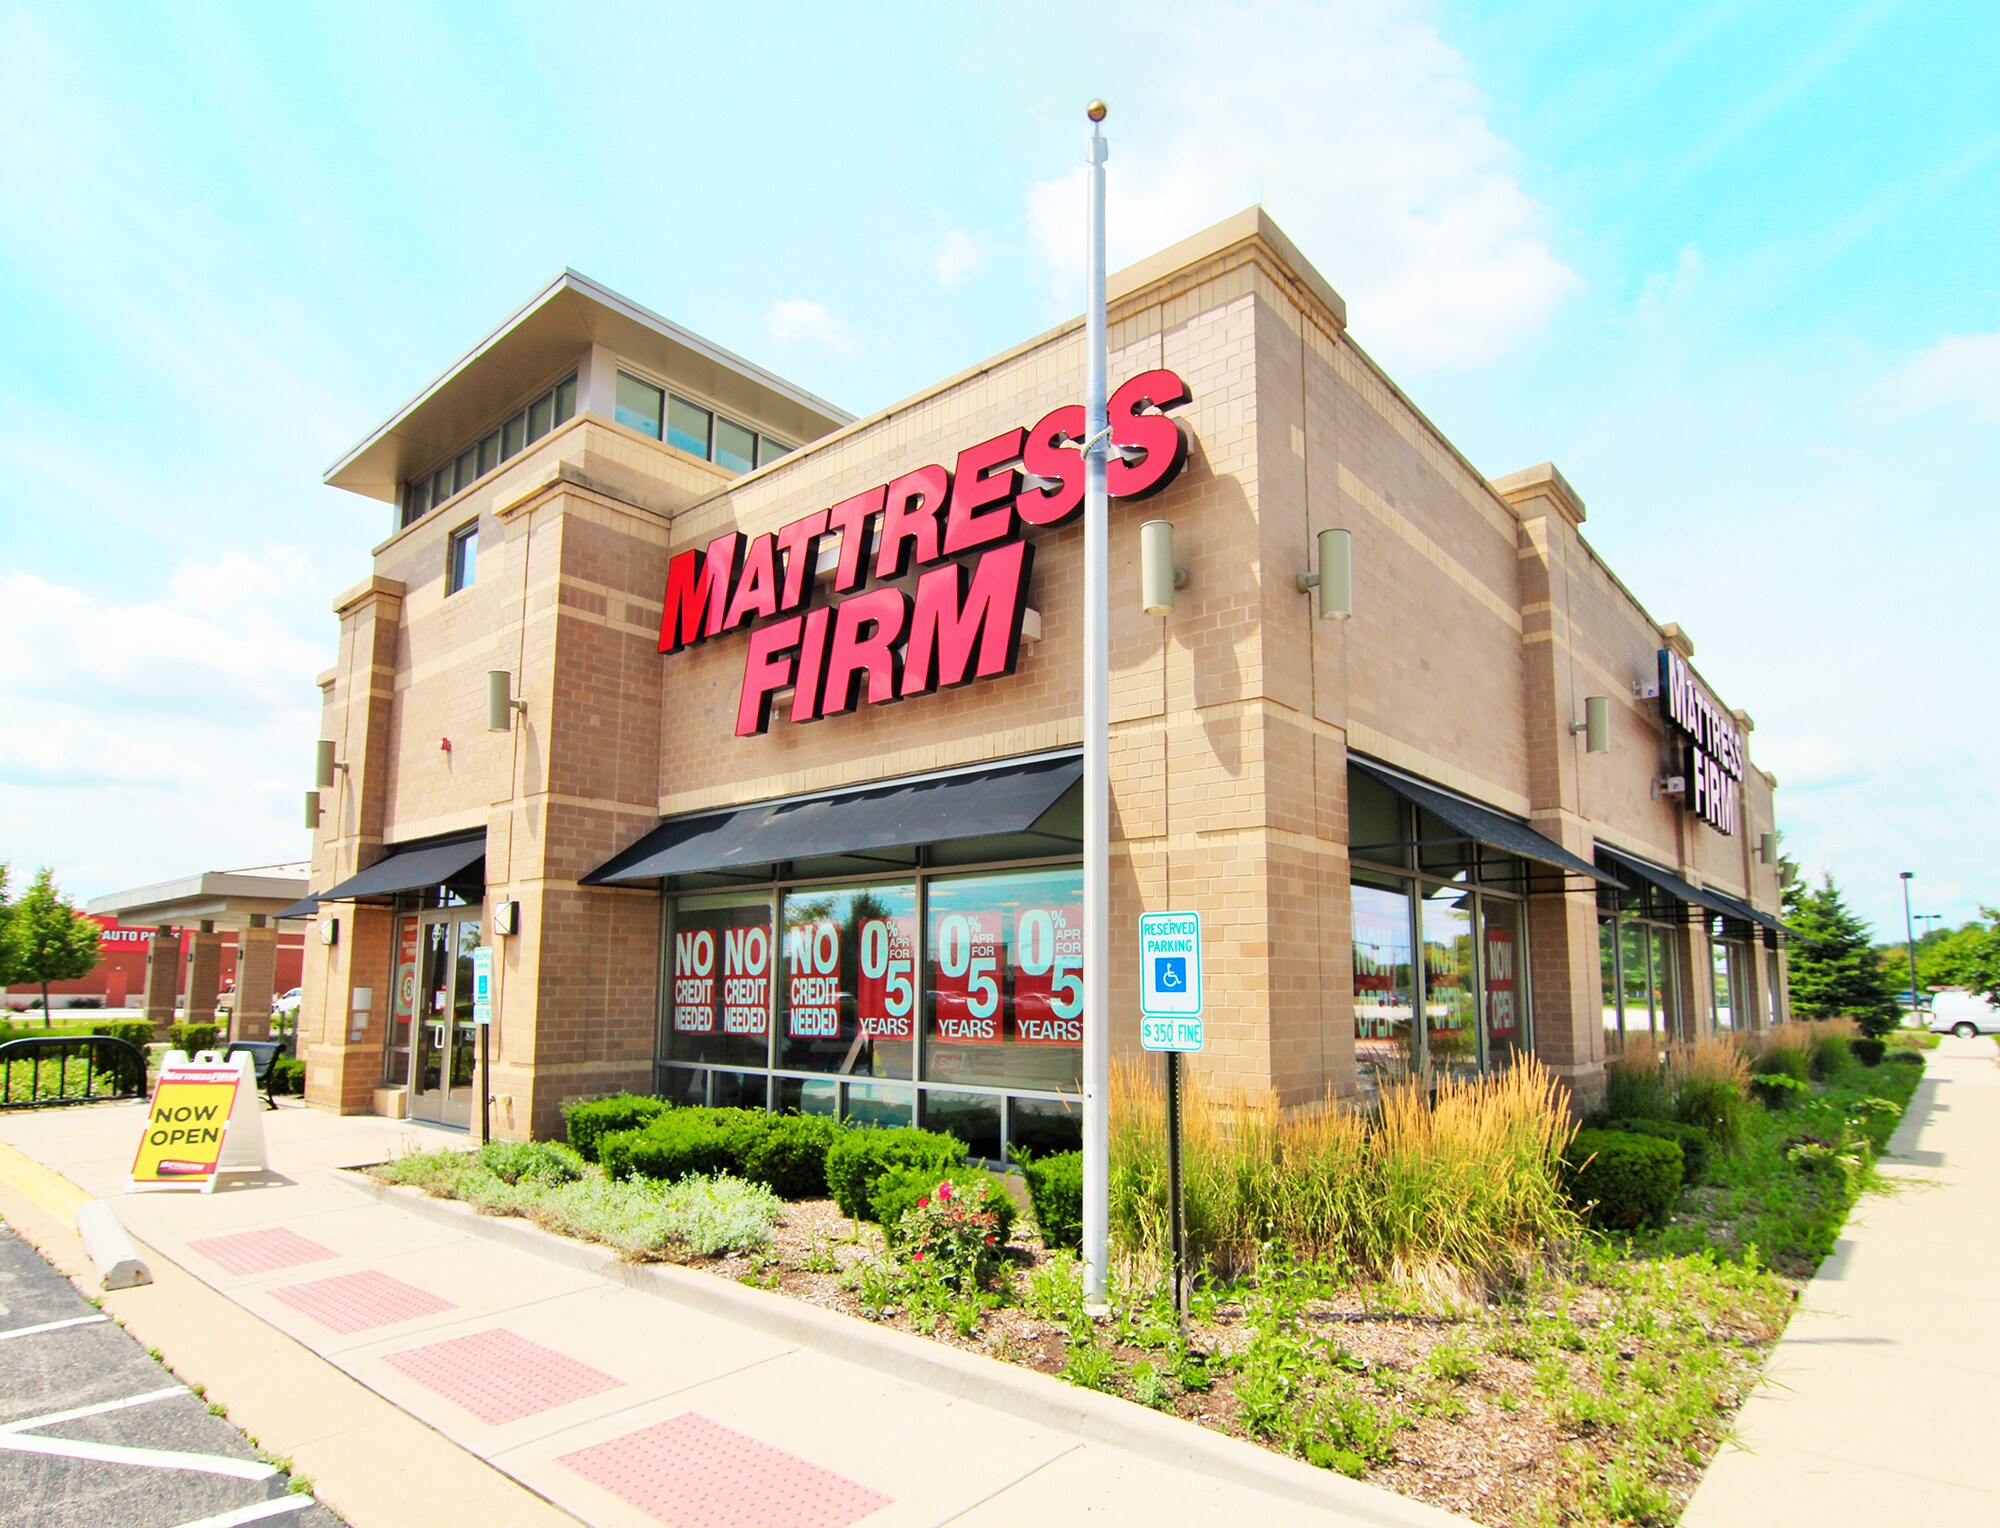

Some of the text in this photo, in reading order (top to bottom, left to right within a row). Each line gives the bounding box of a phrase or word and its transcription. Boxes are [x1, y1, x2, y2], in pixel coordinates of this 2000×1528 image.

[657, 369, 1192, 654] MATTRESS
[735, 540, 1032, 737] FIRM
[1660, 649, 1744, 782] MATTRESS
[1688, 745, 1735, 836] FIRM
[101, 930, 138, 941] AUTO
[971, 934, 995, 944] APR
[1056, 930, 1081, 940] APR
[1144, 922, 1195, 935] RESERVED
[675, 931, 714, 977] NO
[725, 927, 767, 976] NO
[791, 923, 839, 975] NO
[889, 938, 910, 948] APR
[889, 949, 910, 959] FOR
[971, 946, 995, 956] FOR
[1056, 943, 1081, 953] FOR
[1148, 940, 1192, 952] PARKING
[1489, 941, 1512, 980] NOW
[675, 979, 713, 1004] CREDIT
[725, 978, 767, 1005] CREDIT
[791, 977, 838, 1005] CREDIT
[885, 960, 913, 1017] 5
[967, 958, 999, 1018] 5
[1050, 954, 1083, 1019] 5
[674, 1006, 713, 1032] NEEDED
[724, 1007, 766, 1034] NEEDED
[790, 1008, 838, 1036] NEEDED
[1358, 988, 1393, 1039] OPEN
[1434, 986, 1462, 1031] OPEN
[1492, 991, 1514, 1031] OPEN
[1178, 1024, 1201, 1043] FINE
[155, 1105, 218, 1123] NOW
[150, 1127, 219, 1146] OPEN
